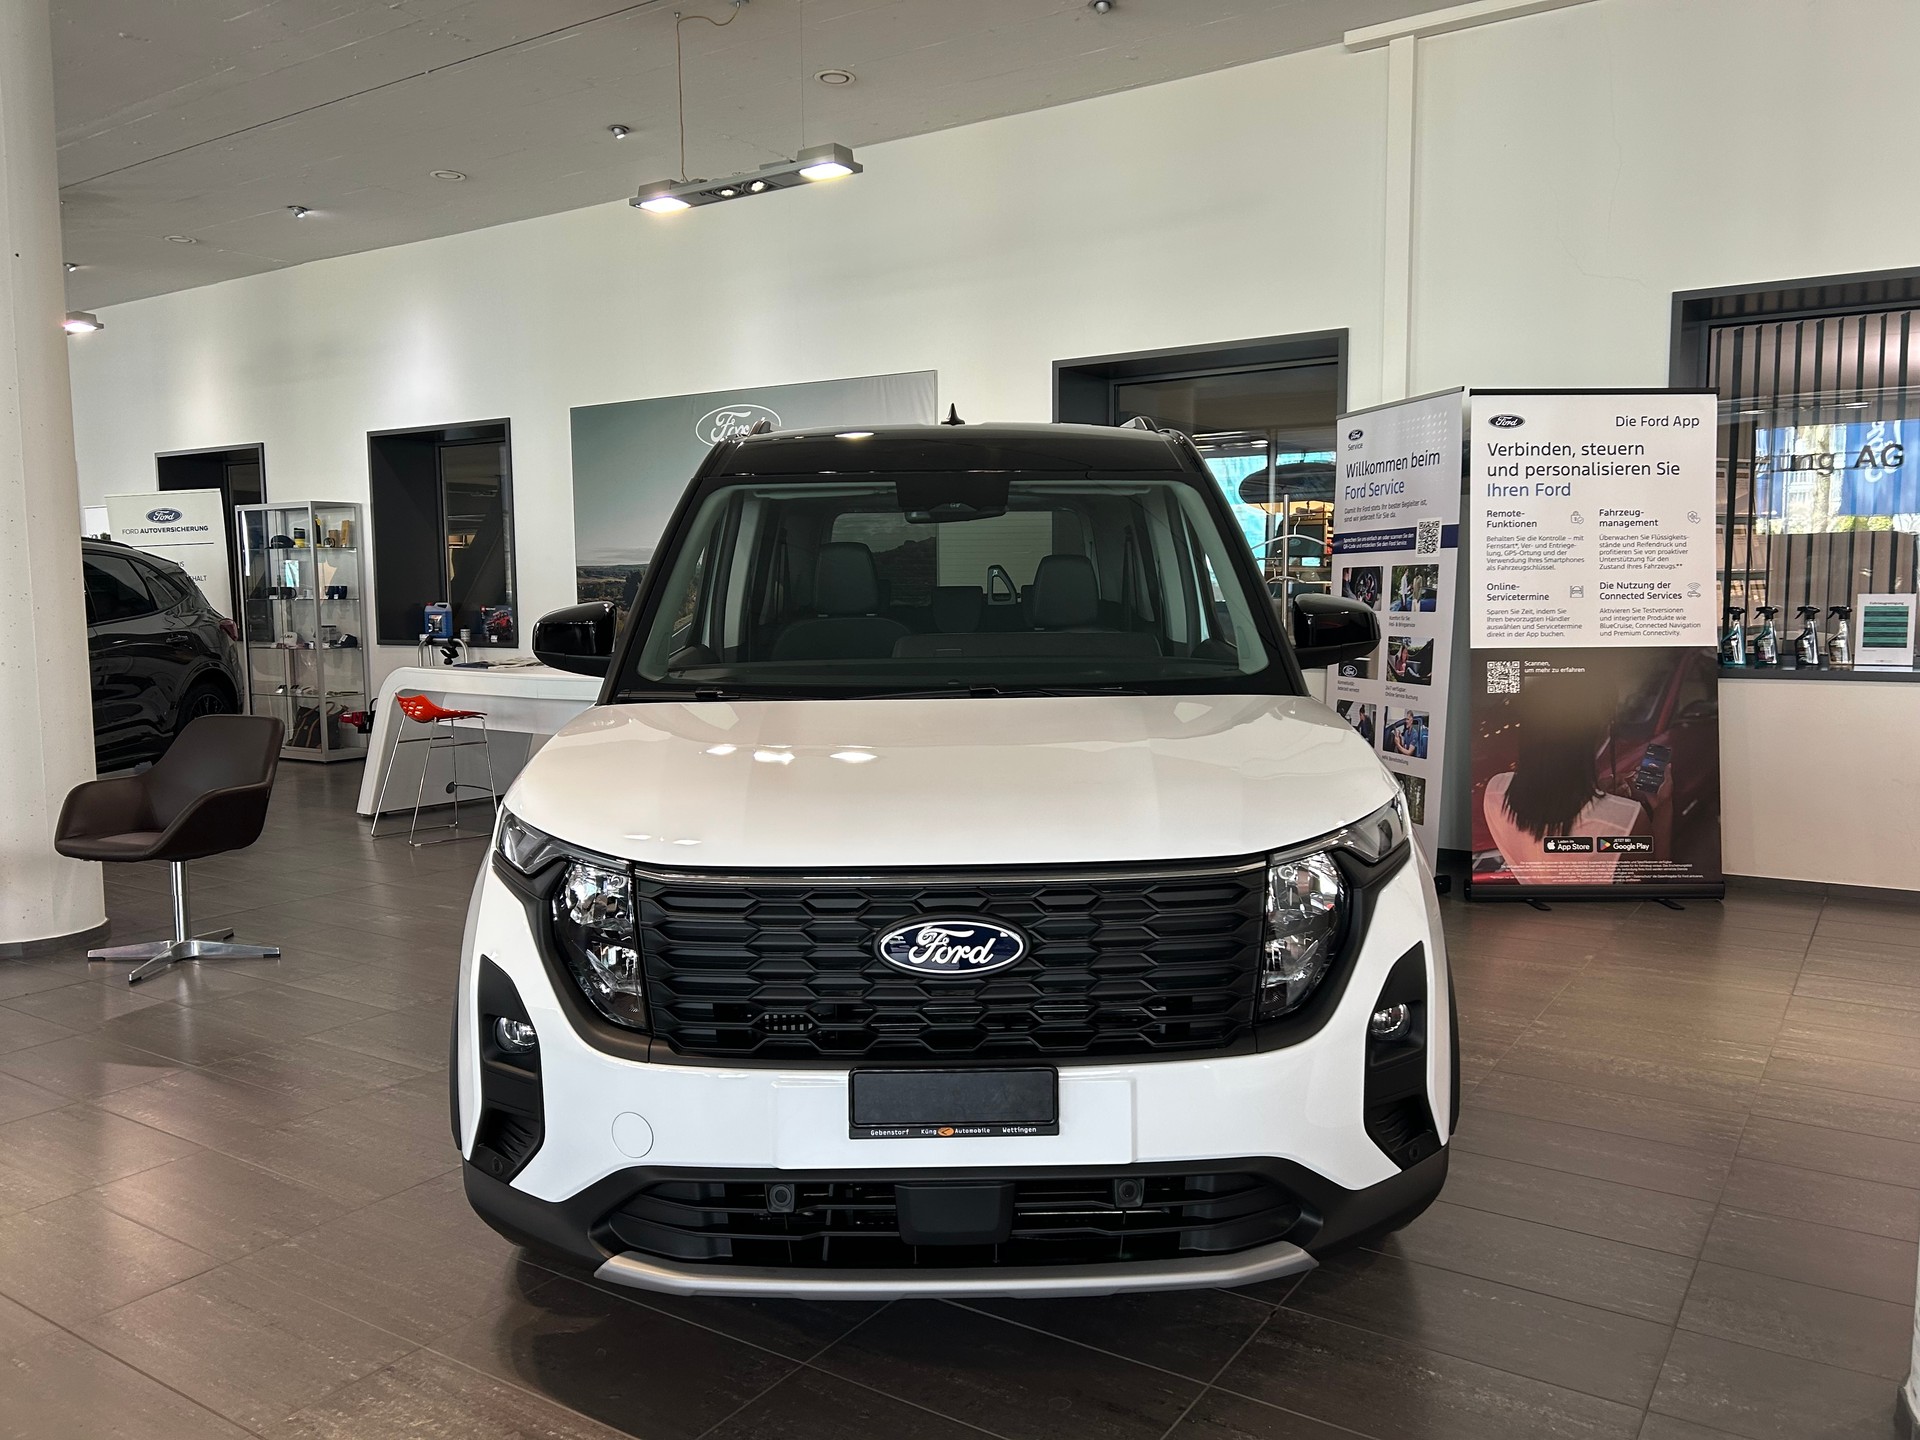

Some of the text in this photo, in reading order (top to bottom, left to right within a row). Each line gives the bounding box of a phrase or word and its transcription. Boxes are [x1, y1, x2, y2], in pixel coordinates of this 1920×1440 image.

[1616, 416, 1699, 428] Die Ford App
[1348, 443, 1363, 451] Service
[1487, 442, 1645, 458] Verbinden, steuern
[1854, 443, 1905, 468] AG
[1346, 450, 1440, 478] Willkommen beim
[1487, 461, 1681, 479] und personalisieren Sie
[1345, 479, 1404, 500] Ford Service
[1487, 482, 1571, 497] Ihren Ford
[153, 510, 175, 520] Ford
[1599, 509, 1644, 517] Fahrzeug-
[1599, 519, 1658, 528] management
[140, 526, 208, 534] AUTOVERSICHERUNG
[1617, 582, 1654, 590] Nutzung
[1657, 581, 1671, 589] der
[1487, 593, 1549, 601] Servicetermine
[1600, 592, 1644, 600] Connected
[1613, 842, 1649, 851] Google Play
[908, 925, 996, 964] Ford
